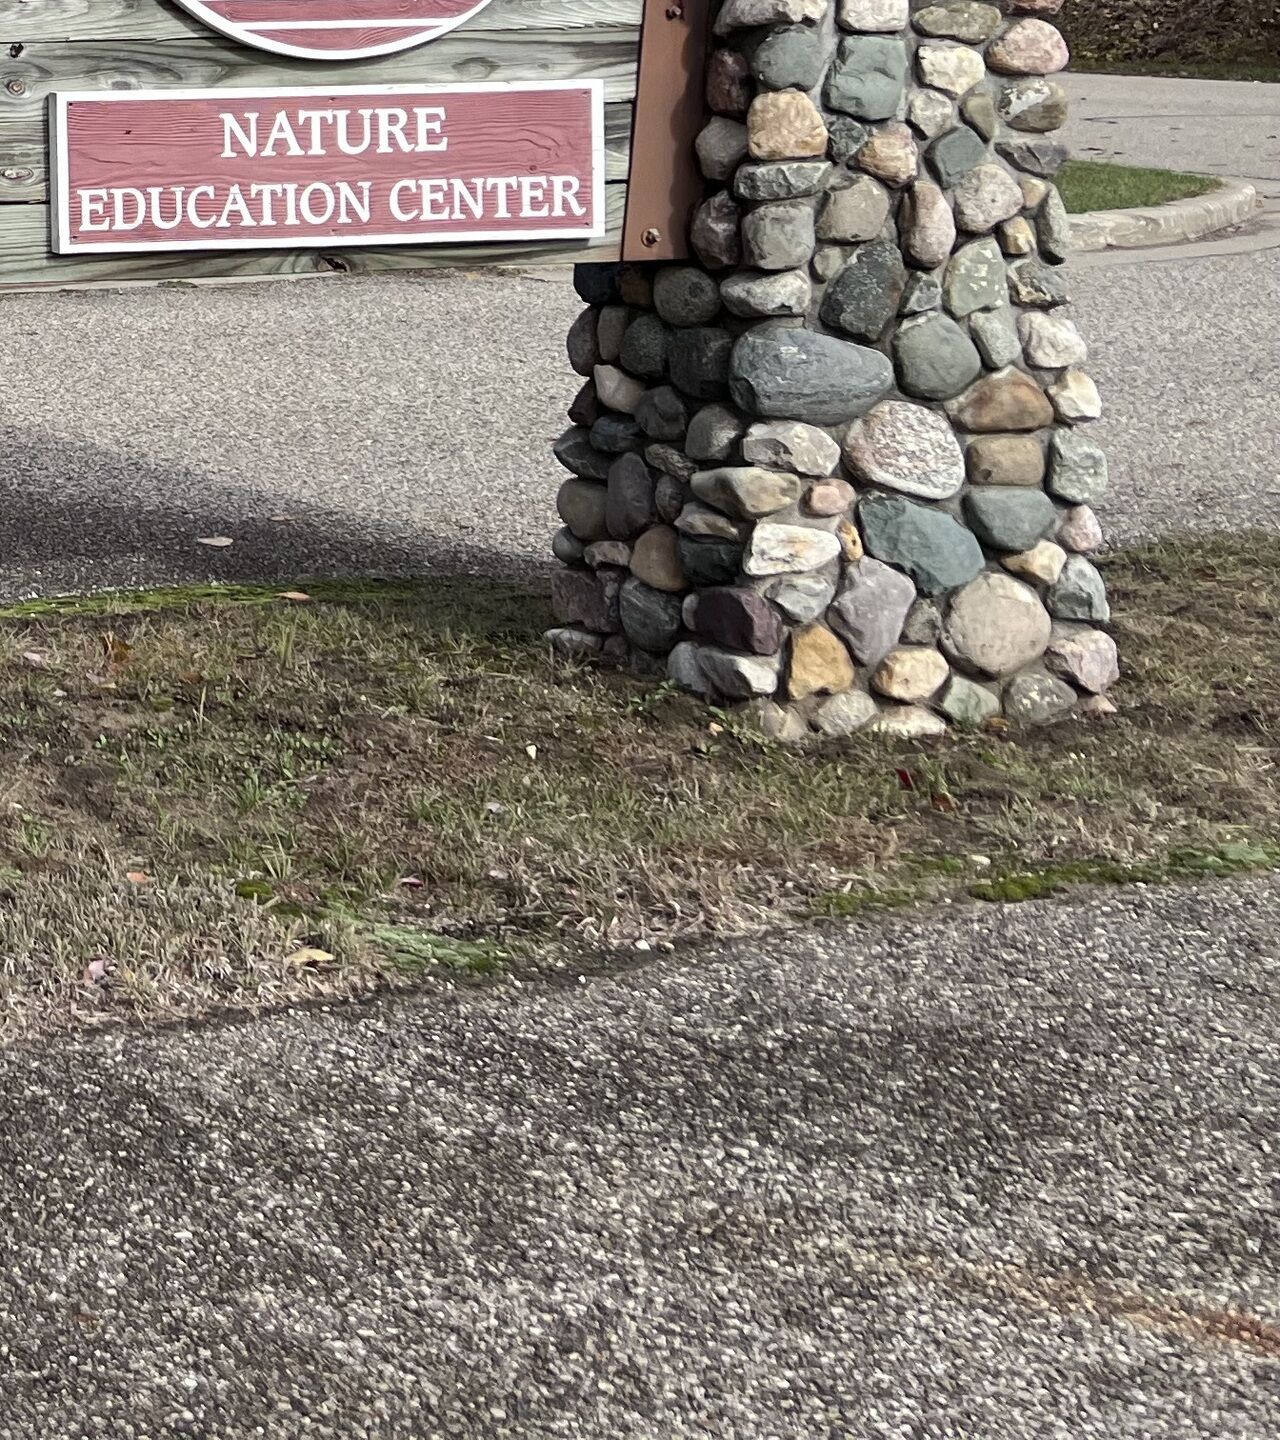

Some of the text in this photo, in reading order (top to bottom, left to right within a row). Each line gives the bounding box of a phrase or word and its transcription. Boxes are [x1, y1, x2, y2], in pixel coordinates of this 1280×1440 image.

[219, 107, 448, 158] NATURE
[77, 175, 587, 232] EDUCATION CENTER
